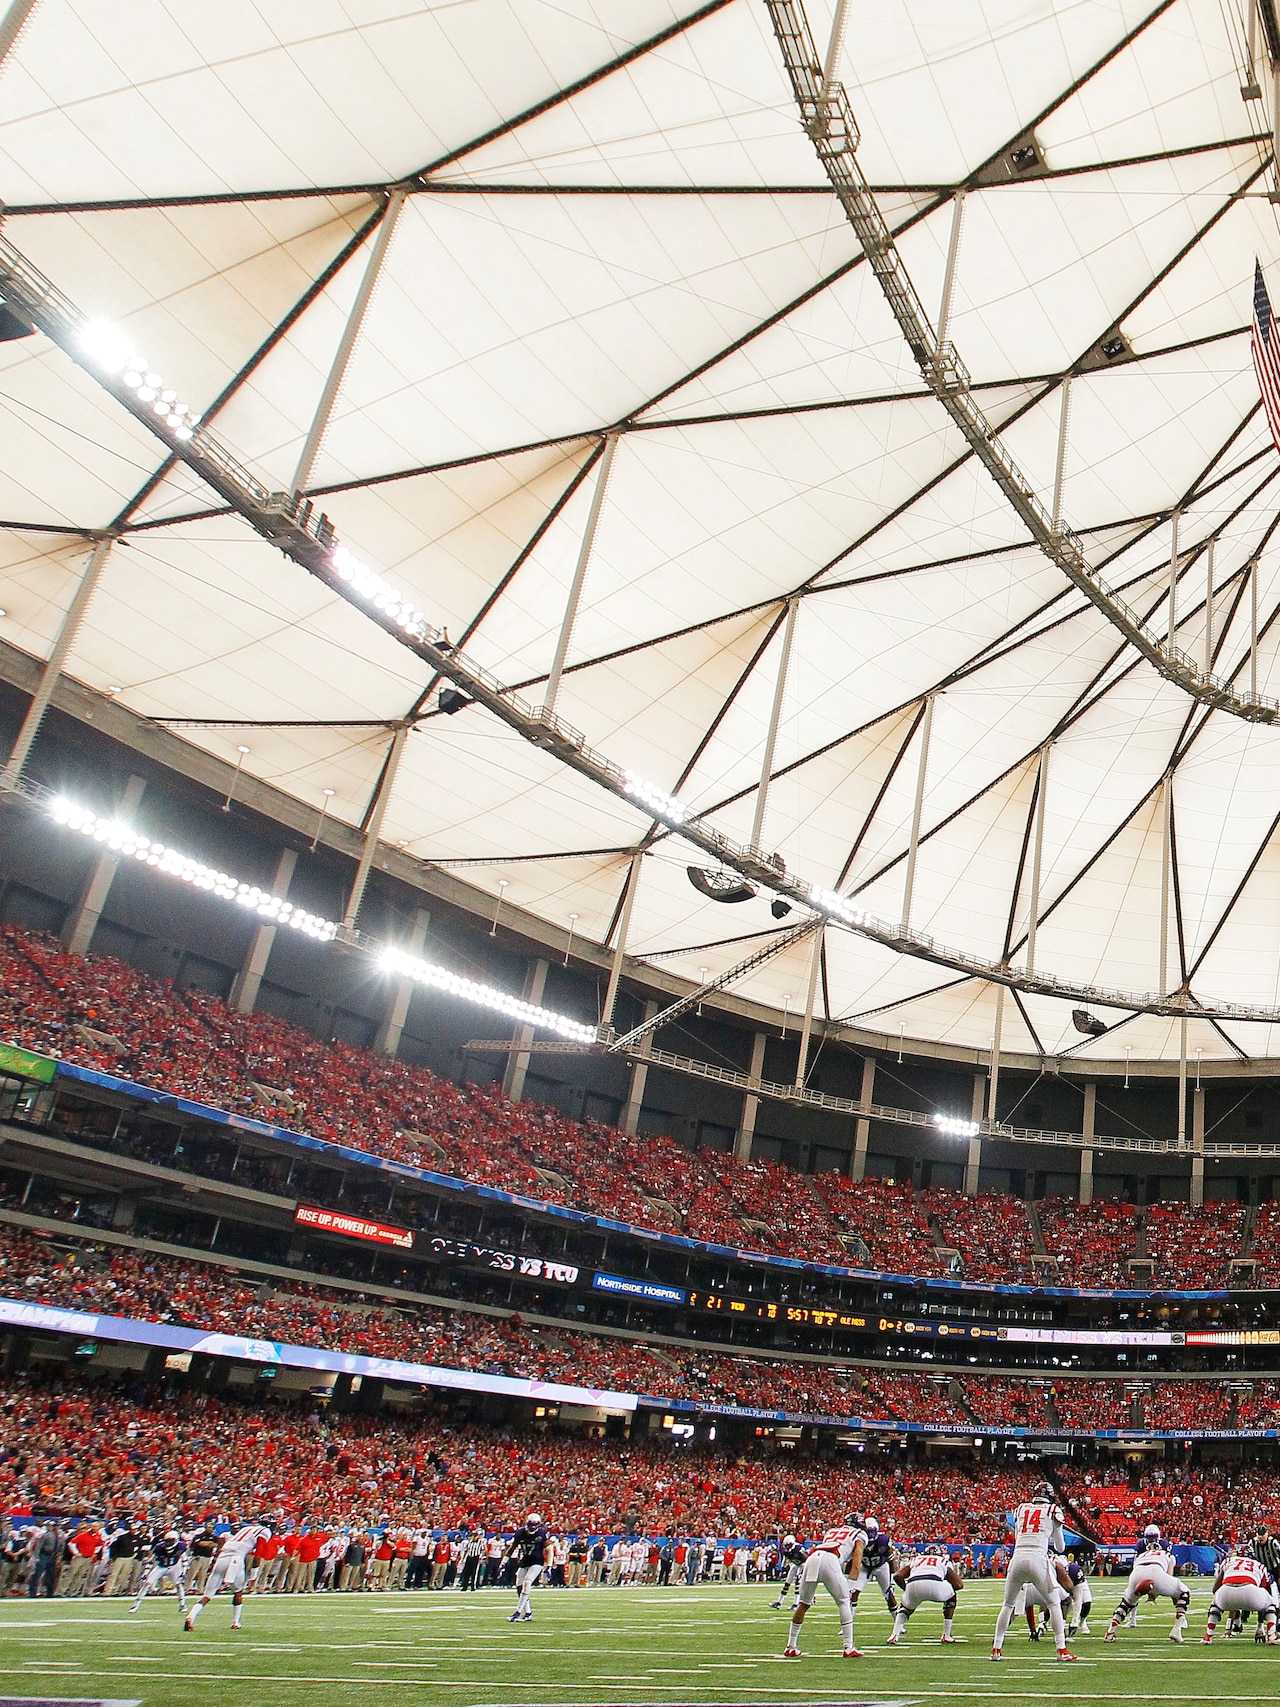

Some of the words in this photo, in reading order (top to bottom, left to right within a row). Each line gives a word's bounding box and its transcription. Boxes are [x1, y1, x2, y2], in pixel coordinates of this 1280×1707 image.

[297, 1208, 317, 1222] RISE
[318, 1213, 332, 1226] UP.
[332, 1217, 363, 1233] POWER
[364, 1224, 378, 1237] UP.
[543, 1260, 579, 1283] TCU
[597, 1276, 643, 1293] NORTHSIDE
[643, 1285, 682, 1300] HOSPITAL
[690, 1292, 697, 1302] 2
[707, 1295, 722, 1309] 21
[730, 1301, 746, 1311] TCU
[787, 1308, 808, 1322] 5:57
[827, 1317, 834, 1326] 2
[840, 1316, 851, 1325] OLE
[851, 1318, 866, 1327] MISS
[896, 1321, 902, 1329] 2
[695, 1401, 721, 1413] COLLEGE
[722, 1405, 752, 1416] FOOTBALL
[752, 1409, 777, 1419] PLAYOFF
[923, 1424, 952, 1433] COLLEGE
[953, 1425, 987, 1435] FOOTBALL
[987, 1426, 1015, 1435] PLAYOFF
[1025, 1428, 1057, 1436] SEMIFINAL
[1175, 1430, 1203, 1438] COLLEGE
[1204, 1430, 1238, 1438] FOOTBALL
[1022, 1509, 1042, 1533] 14
[825, 1530, 850, 1543] 22
[916, 1557, 938, 1567] 78
[1233, 1558, 1255, 1573] 73
